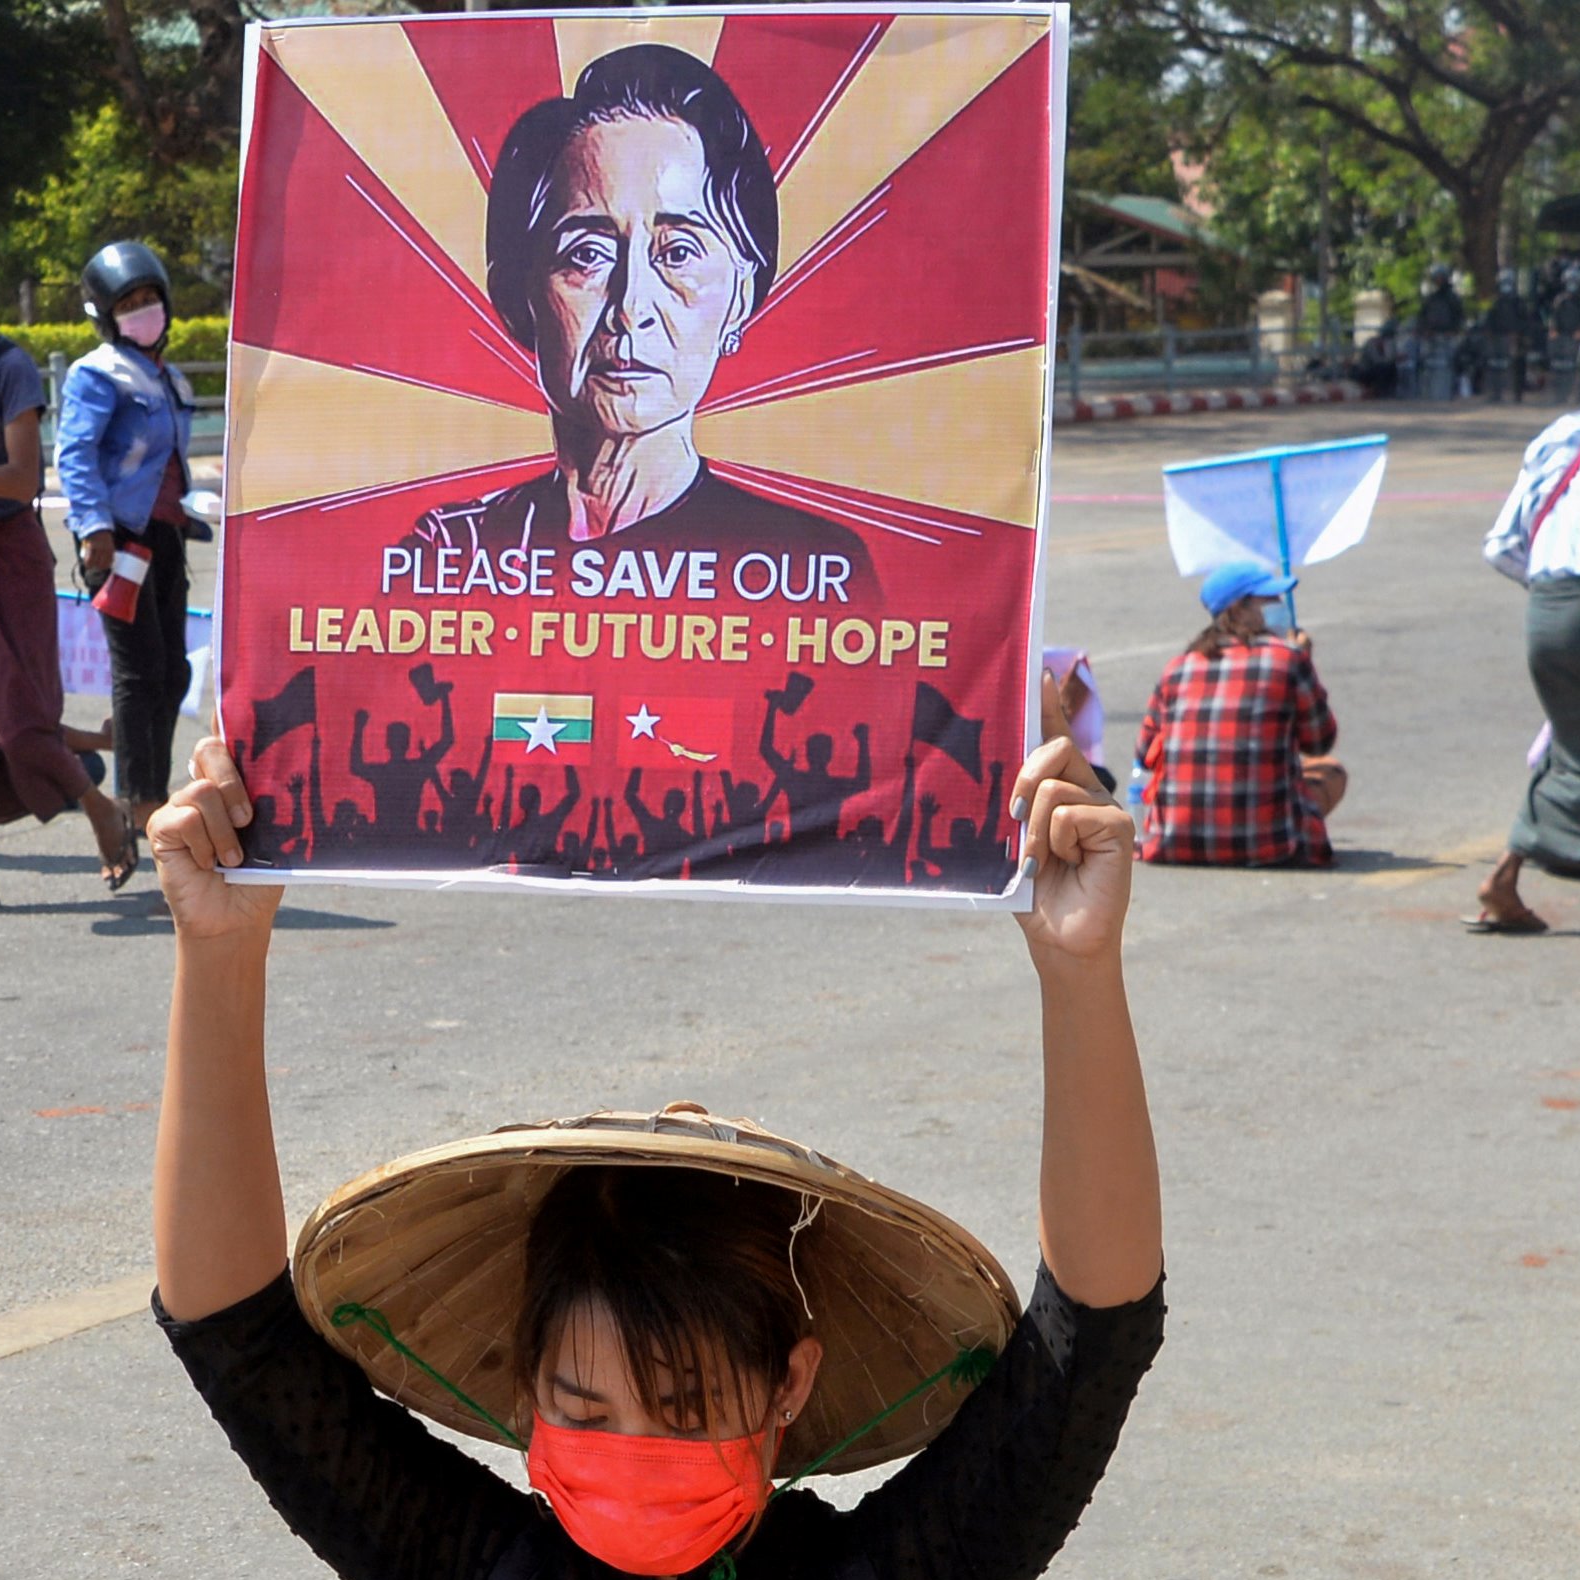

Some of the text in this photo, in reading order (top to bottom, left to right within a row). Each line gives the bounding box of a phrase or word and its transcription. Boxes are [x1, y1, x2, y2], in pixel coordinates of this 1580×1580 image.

[381, 547, 851, 602] PLEASE SAVE OUR
[289, 607, 950, 668] LEADER FUTURE HOPE
